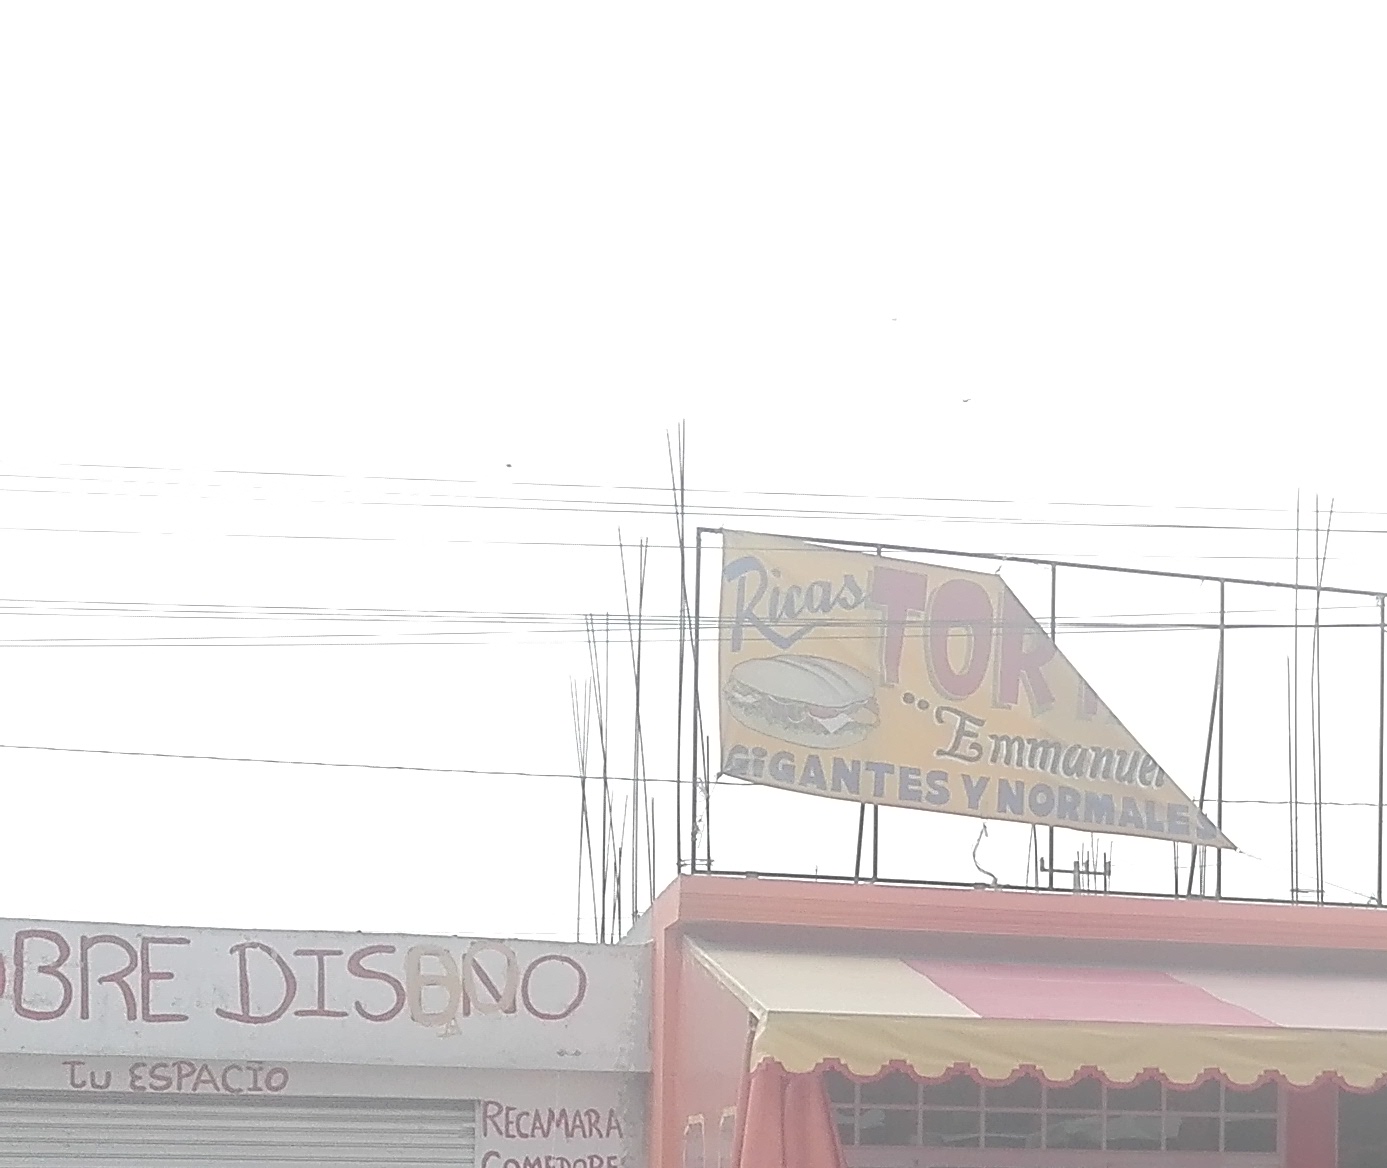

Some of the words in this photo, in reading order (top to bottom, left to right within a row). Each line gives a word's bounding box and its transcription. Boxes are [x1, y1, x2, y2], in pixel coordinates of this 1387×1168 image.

[722, 555, 867, 653] Ricas
[963, 774, 990, 812] Y
[0, 929, 191, 1022] BRE
[128, 1060, 290, 1094] ESPACIO
